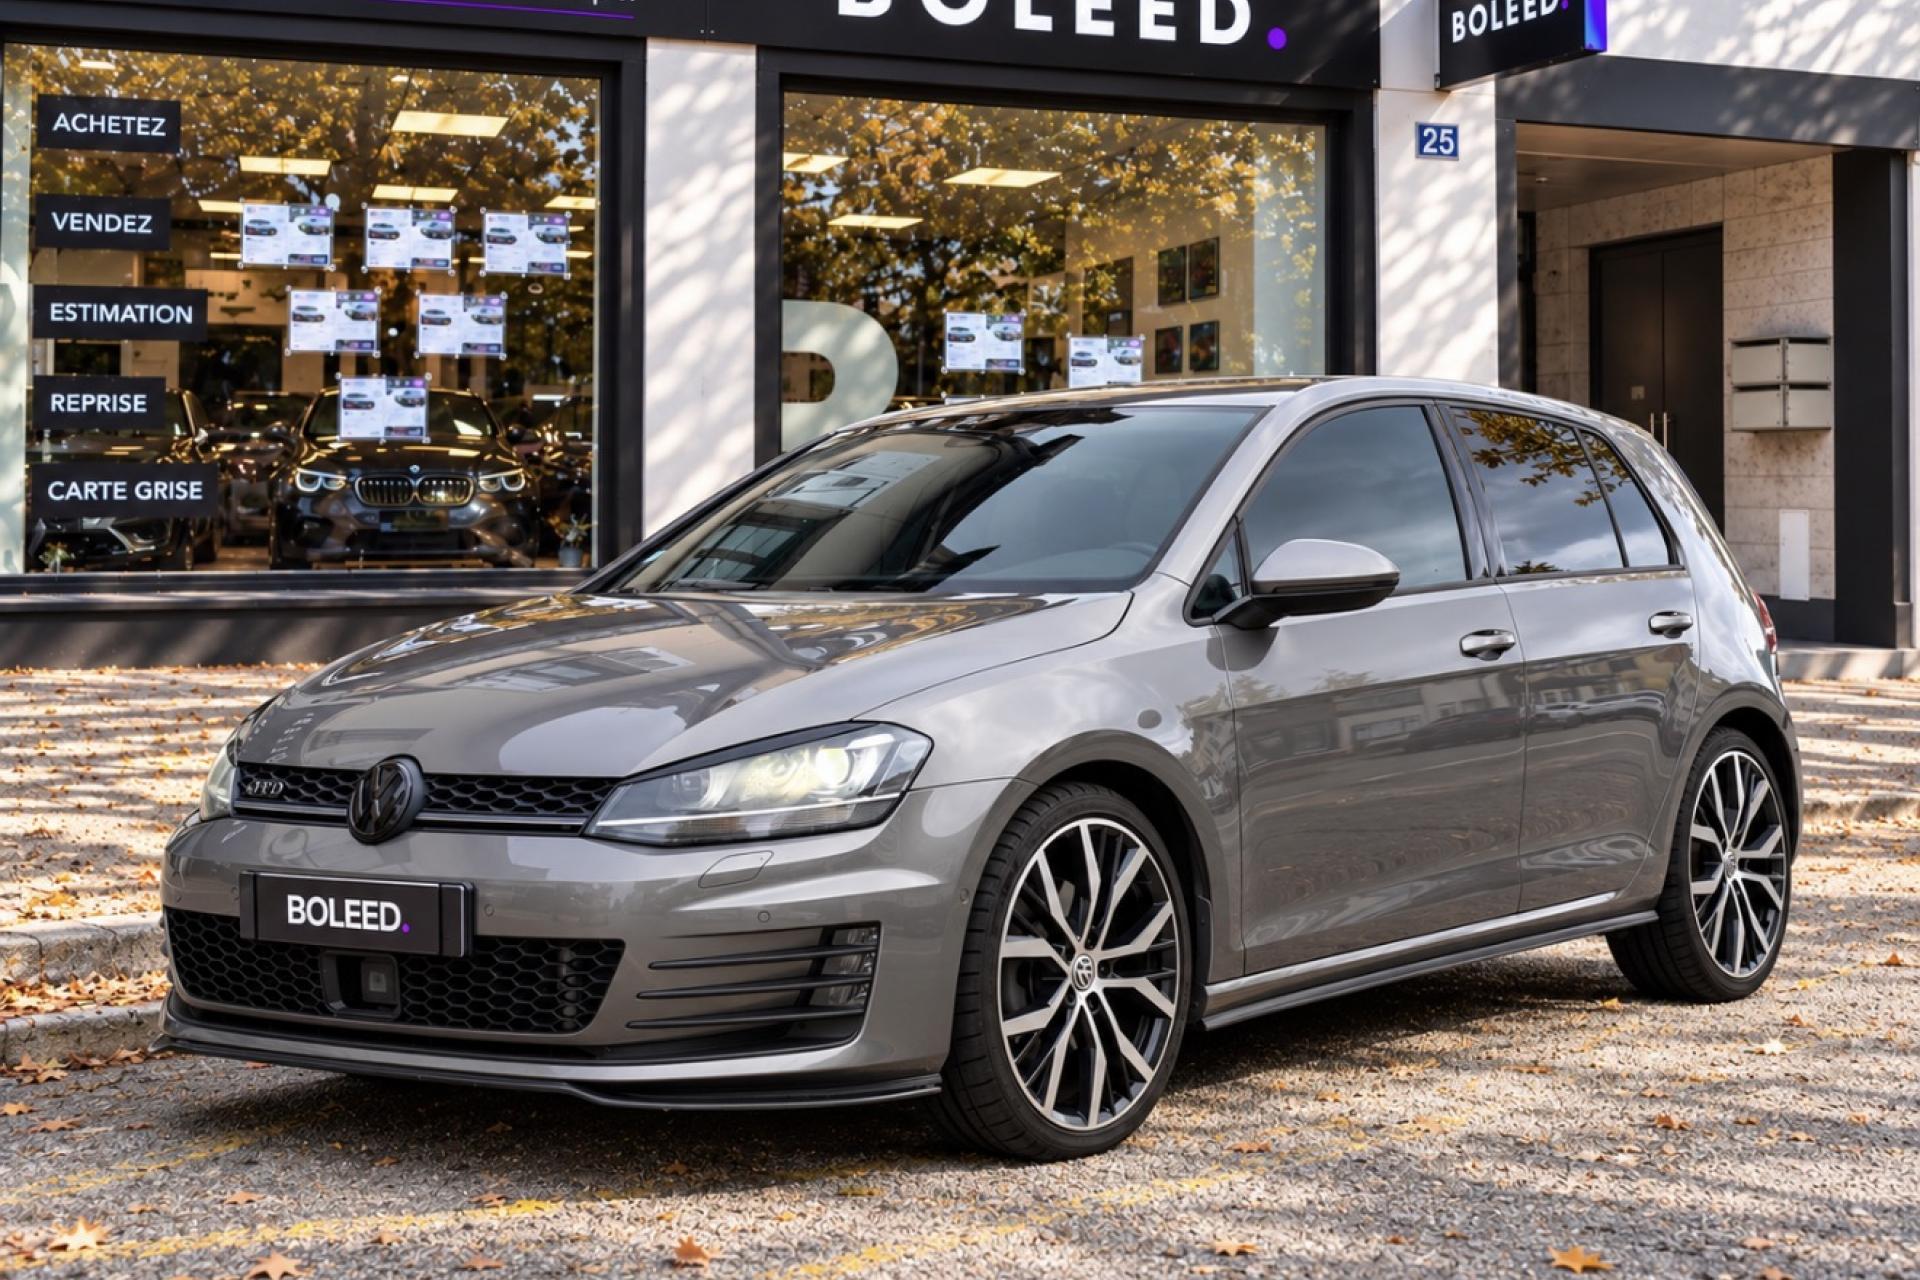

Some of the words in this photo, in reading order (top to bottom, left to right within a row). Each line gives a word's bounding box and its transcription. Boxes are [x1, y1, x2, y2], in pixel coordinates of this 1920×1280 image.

[838, 0, 1287, 50] LEED.
[52, 112, 166, 137] ACHETEZ
[1423, 127, 1454, 155] 25
[51, 211, 153, 234] VENDEZ
[50, 302, 193, 325] ESTIMATION
[50, 393, 147, 413] REPRISE
[47, 480, 128, 501] CARTE
[134, 480, 203, 501] GRISE
